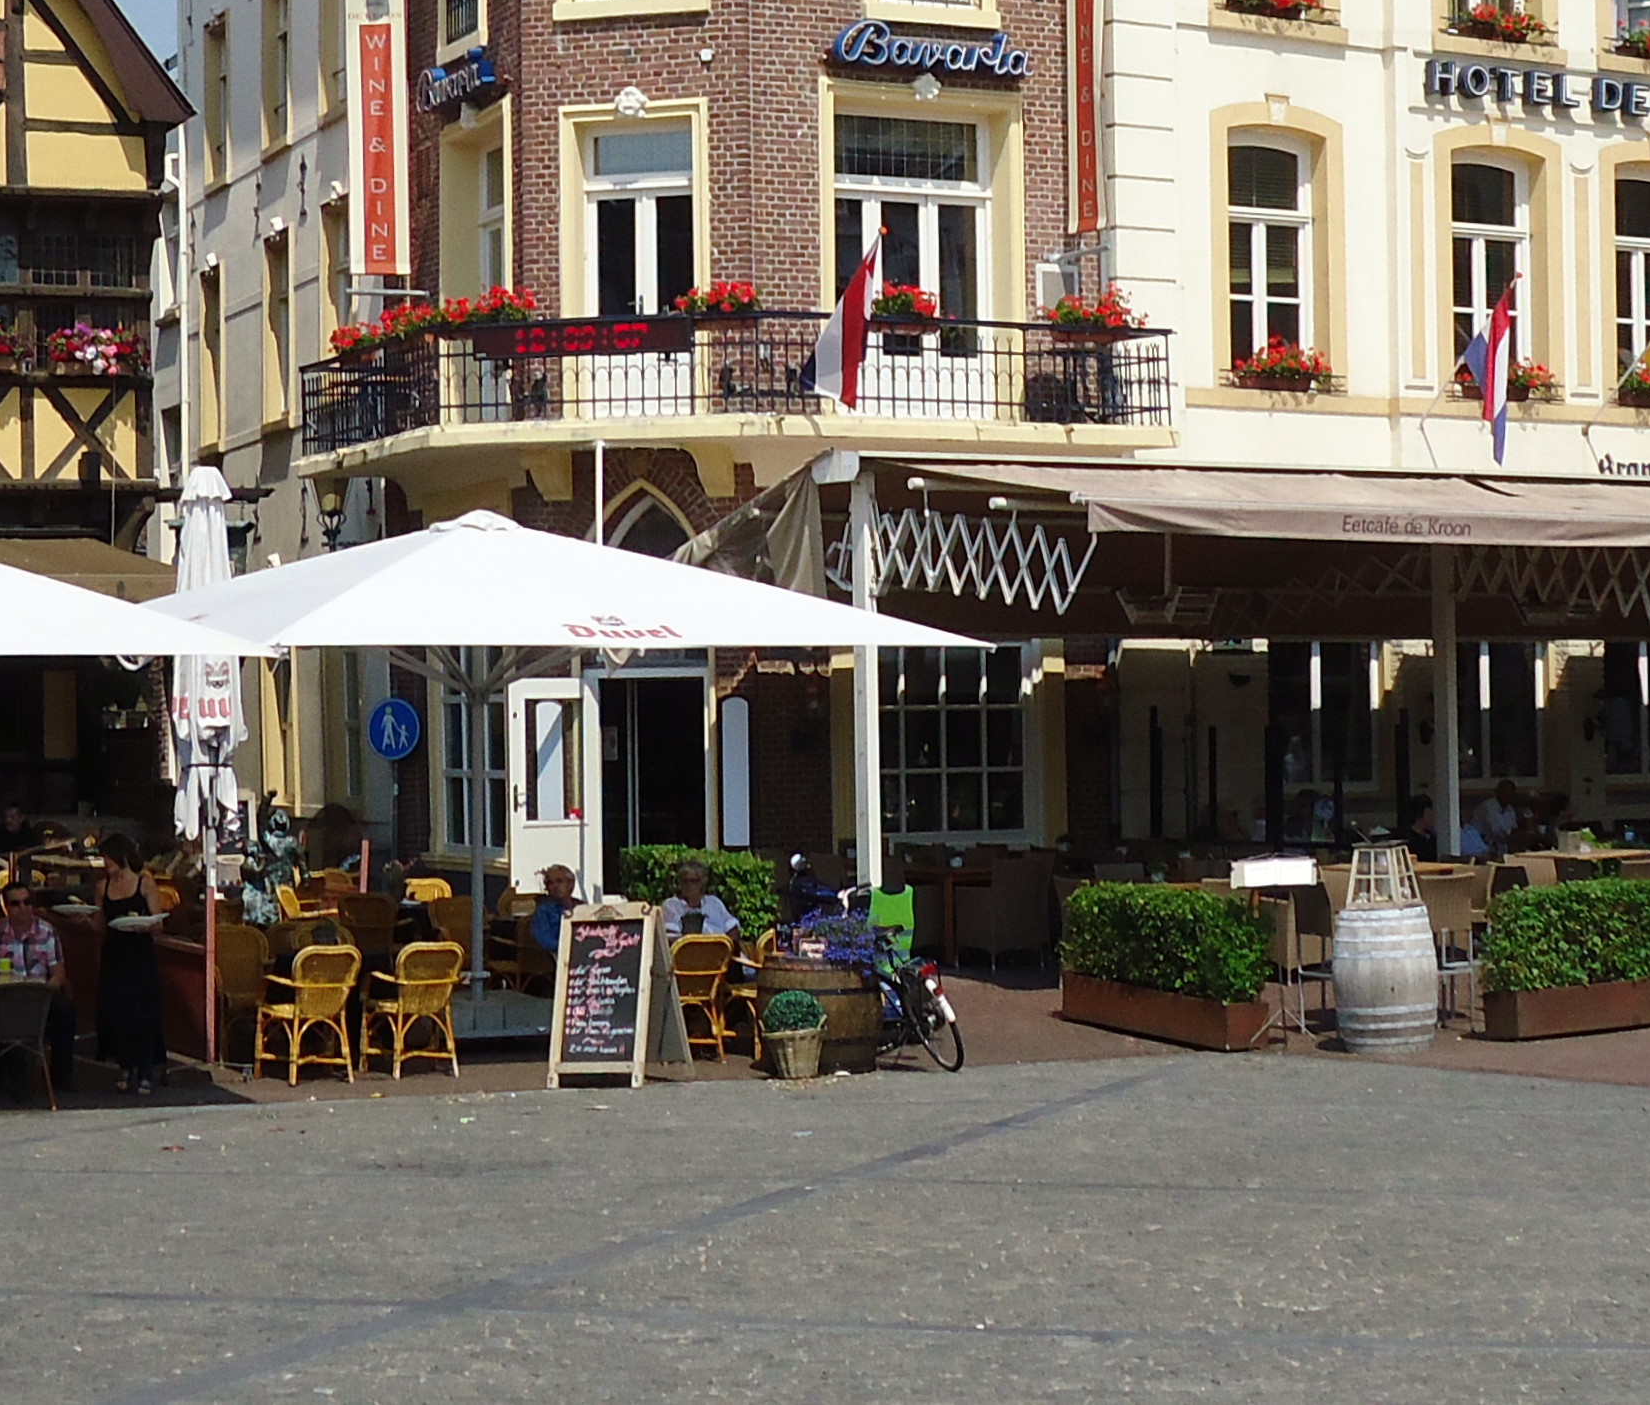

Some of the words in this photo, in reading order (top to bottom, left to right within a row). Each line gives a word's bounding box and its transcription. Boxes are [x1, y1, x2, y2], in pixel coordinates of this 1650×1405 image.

[365, 34, 385, 117] WINE
[832, 18, 1035, 77] Bavaria
[1426, 59, 1581, 108] HOTEL
[1592, 77, 1650, 117] DE
[369, 137, 386, 154] &
[370, 177, 390, 261] DINE
[1342, 515, 1400, 535] Eetcafé
[1404, 516, 1423, 535] de
[1428, 518, 1472, 537] Kroon
[561, 624, 683, 639] Duvel
